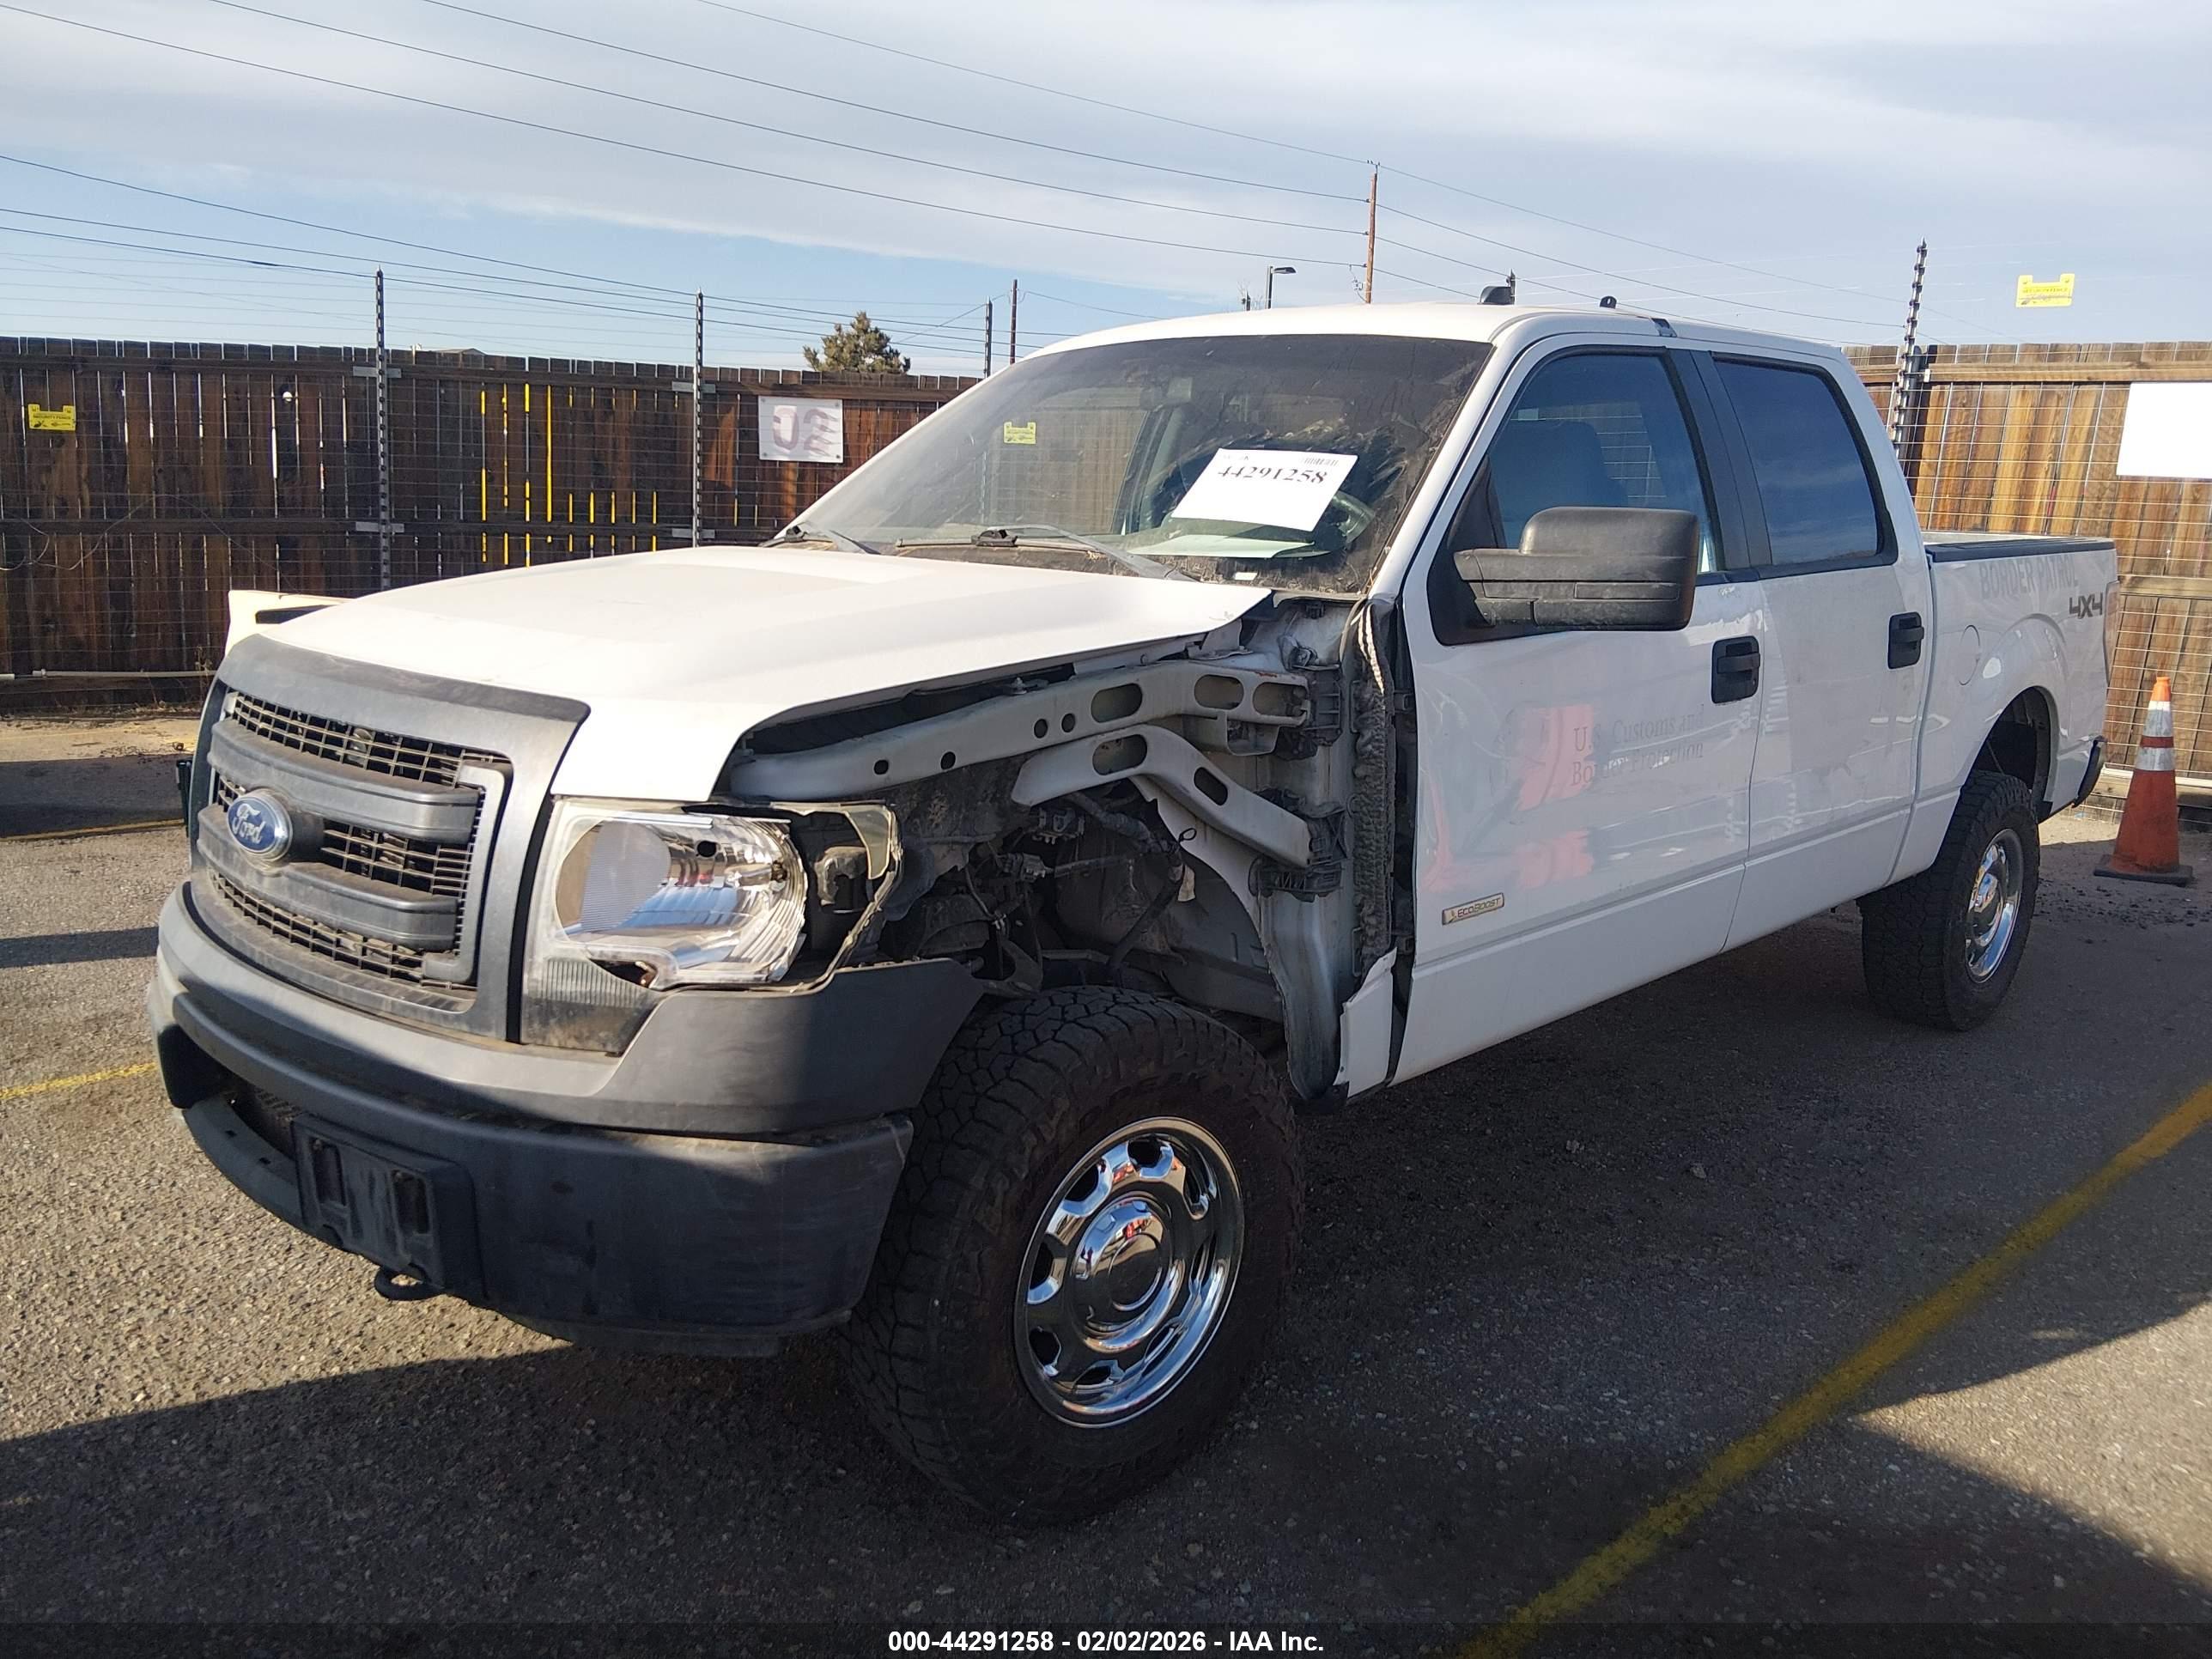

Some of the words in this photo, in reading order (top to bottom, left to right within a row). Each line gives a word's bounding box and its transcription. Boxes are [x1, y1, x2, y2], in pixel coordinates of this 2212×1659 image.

[1218, 465, 1327, 483] 44291258
[1978, 558, 2036, 599] BORDER
[2037, 554, 2078, 592] PATROL
[1573, 724, 1602, 752] U.S
[1613, 716, 1676, 744] Customs
[232, 803, 266, 844] Ford
